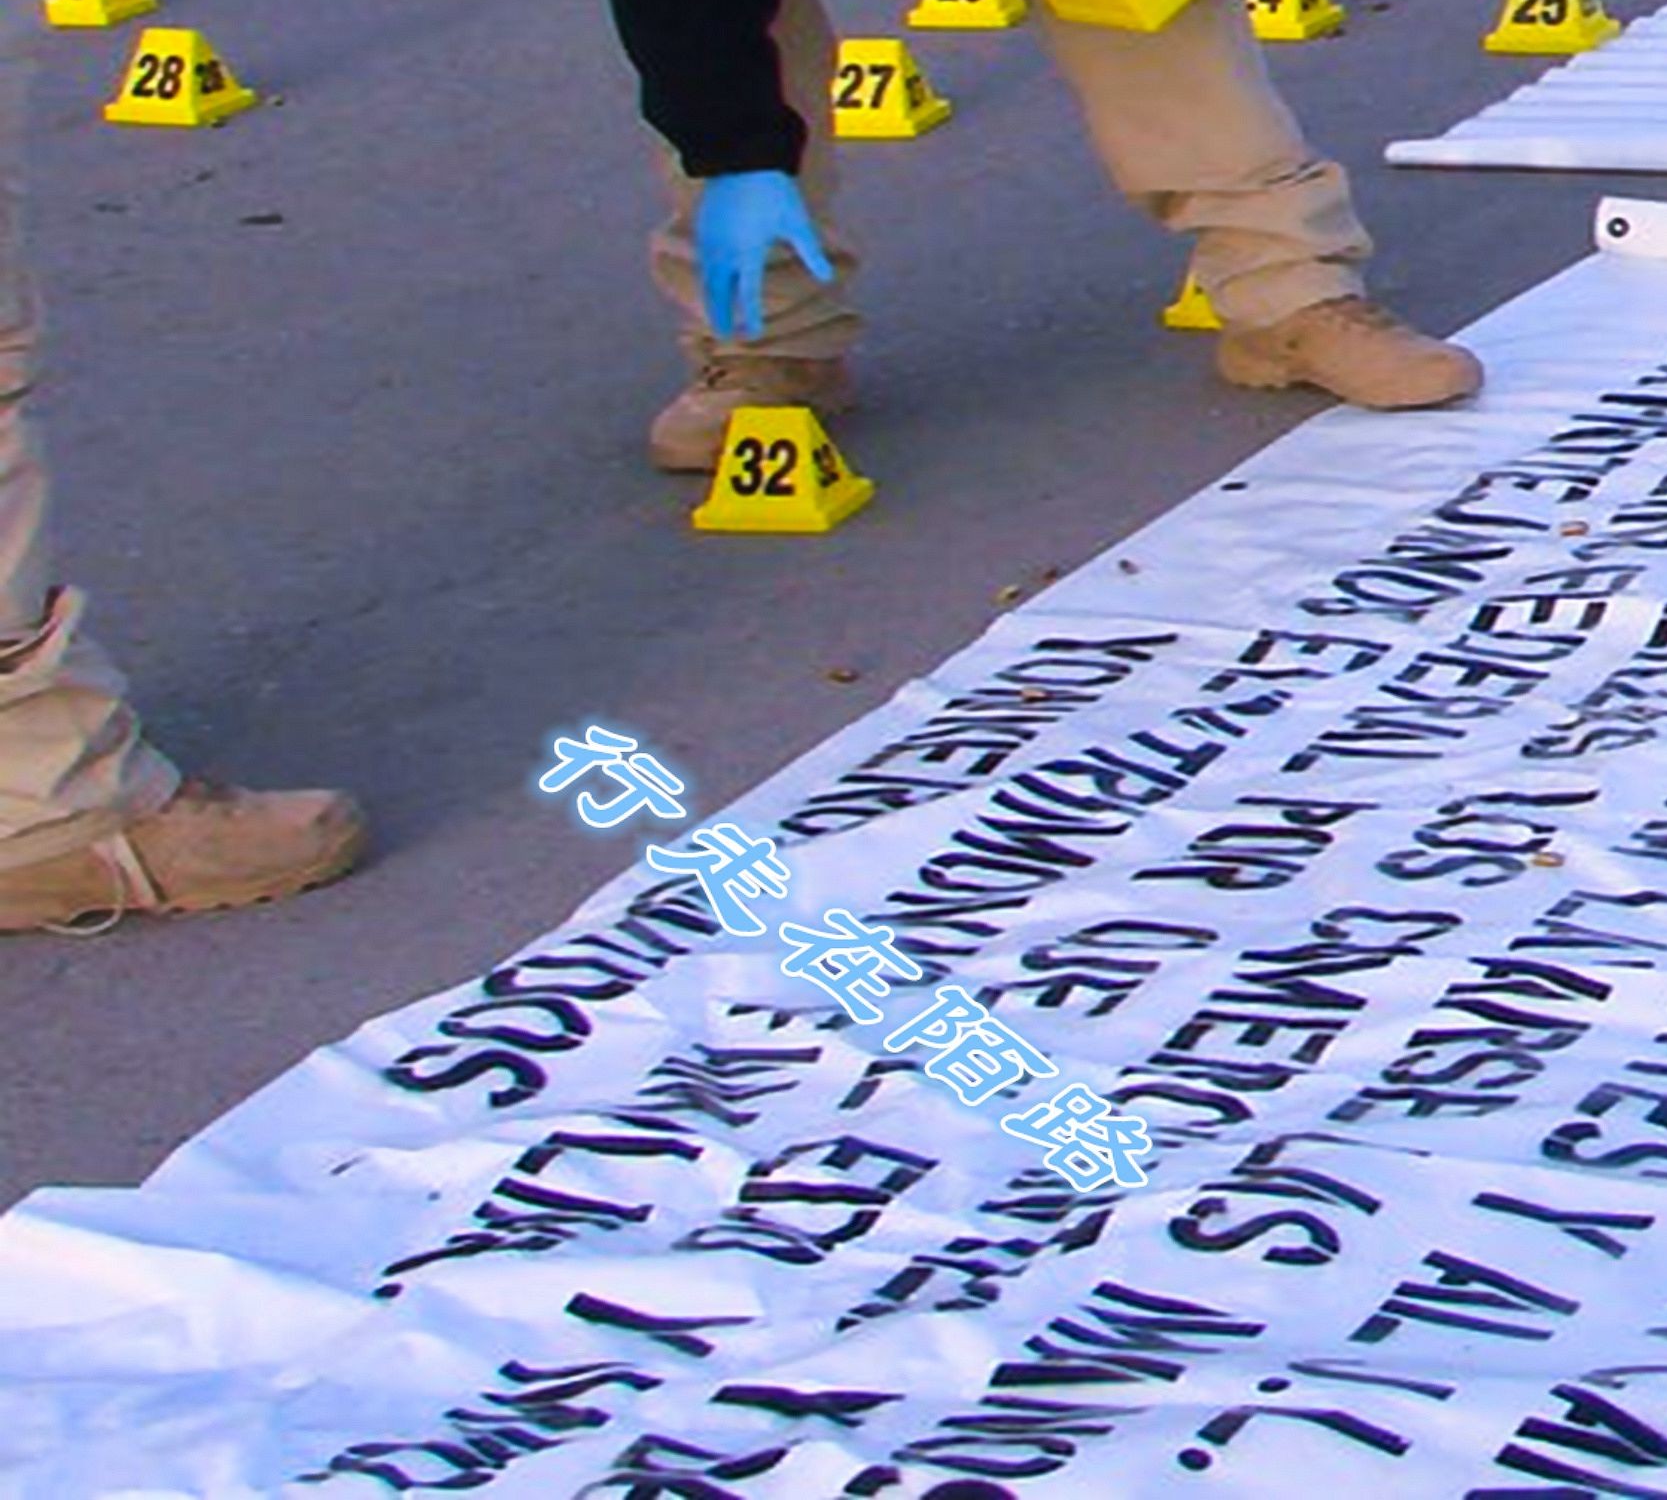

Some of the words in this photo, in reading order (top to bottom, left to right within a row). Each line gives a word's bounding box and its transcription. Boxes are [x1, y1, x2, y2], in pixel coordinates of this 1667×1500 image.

[131, 53, 186, 101] 28
[836, 64, 896, 110] 27
[730, 437, 798, 497] 32
